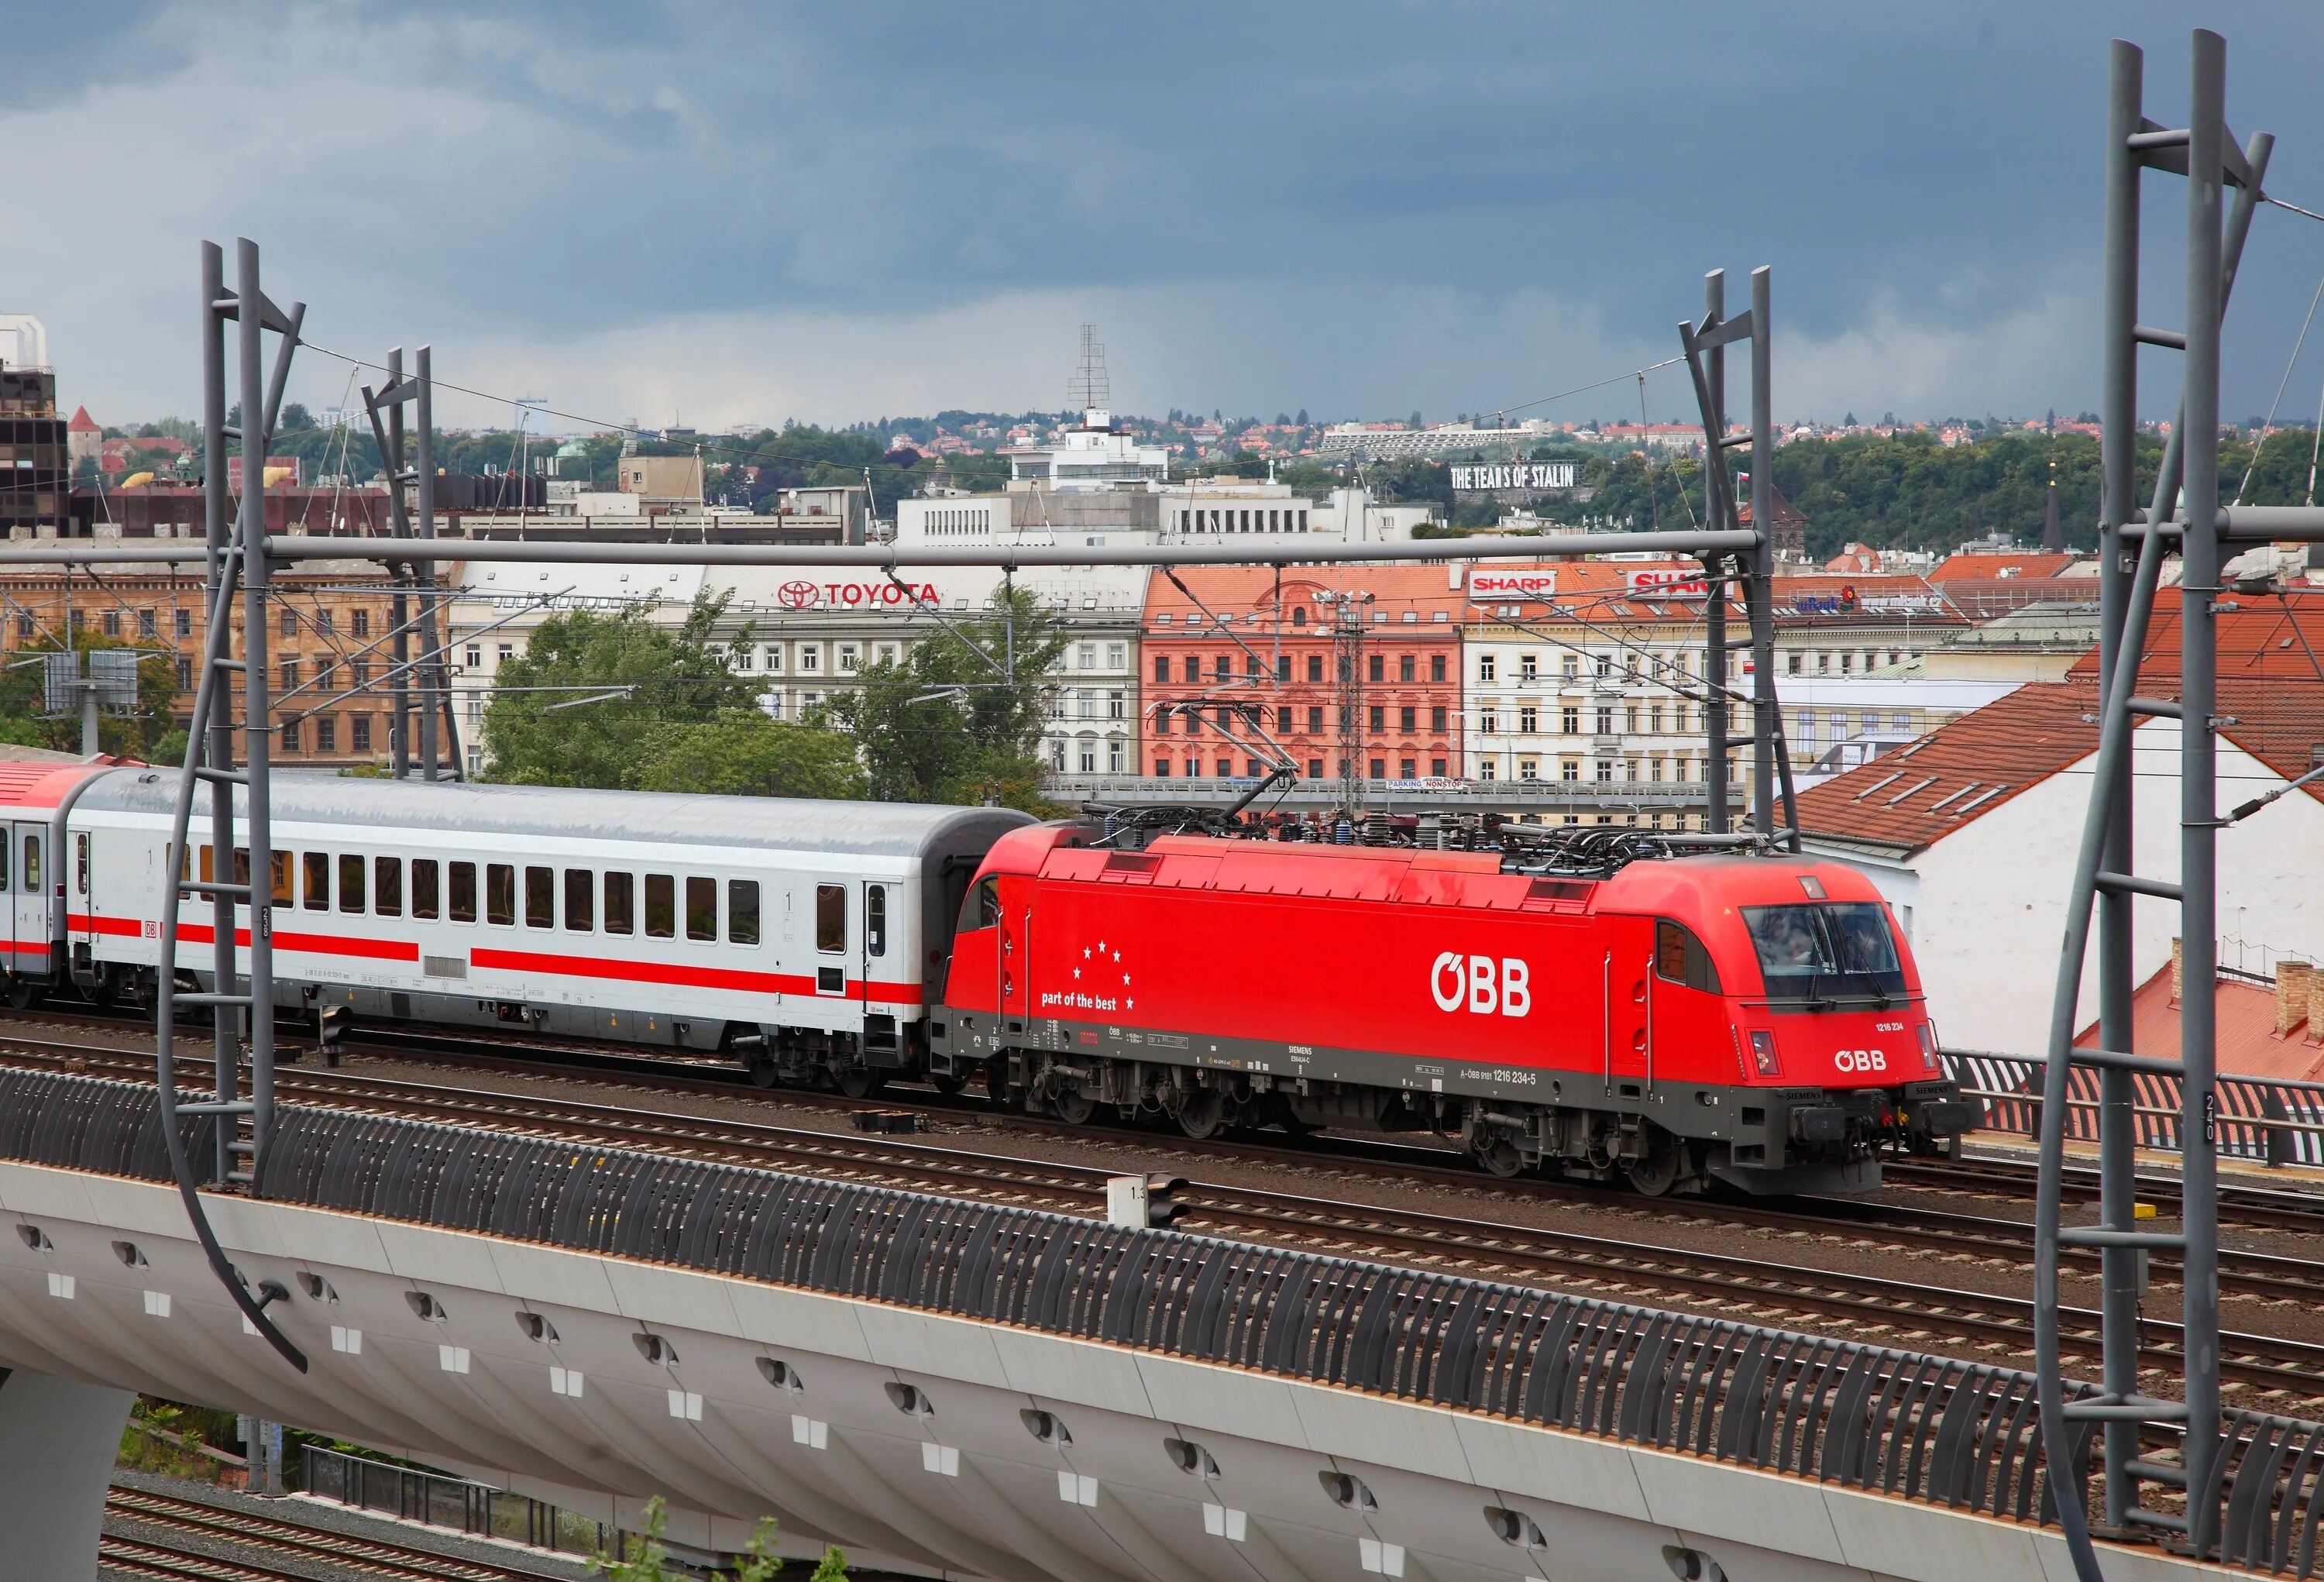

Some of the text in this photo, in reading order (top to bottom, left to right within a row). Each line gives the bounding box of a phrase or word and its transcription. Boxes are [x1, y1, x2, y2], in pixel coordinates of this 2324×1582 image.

[1451, 466, 1471, 489] THE
[1513, 466, 1528, 487] OF
[1532, 466, 1573, 487] STALIN
[1473, 578, 1550, 590] SHARP
[825, 583, 940, 604] TOYOTA
[786, 891, 791, 911] 1
[146, 923, 155, 935] DB
[1431, 951, 1531, 1017] ÖBB
[1042, 992, 1116, 1010] part of the best
[1892, 1022, 1903, 1030] 234
[1288, 1046, 1312, 1054] SIEMENS
[1834, 1050, 1886, 1072] ÖBB
[1460, 1069, 1536, 1085] A-ÖBB 9181 1216 234-5
[1786, 1092, 1820, 1100] SIEMENS
[1916, 1086, 1948, 1095] SIEMENS
